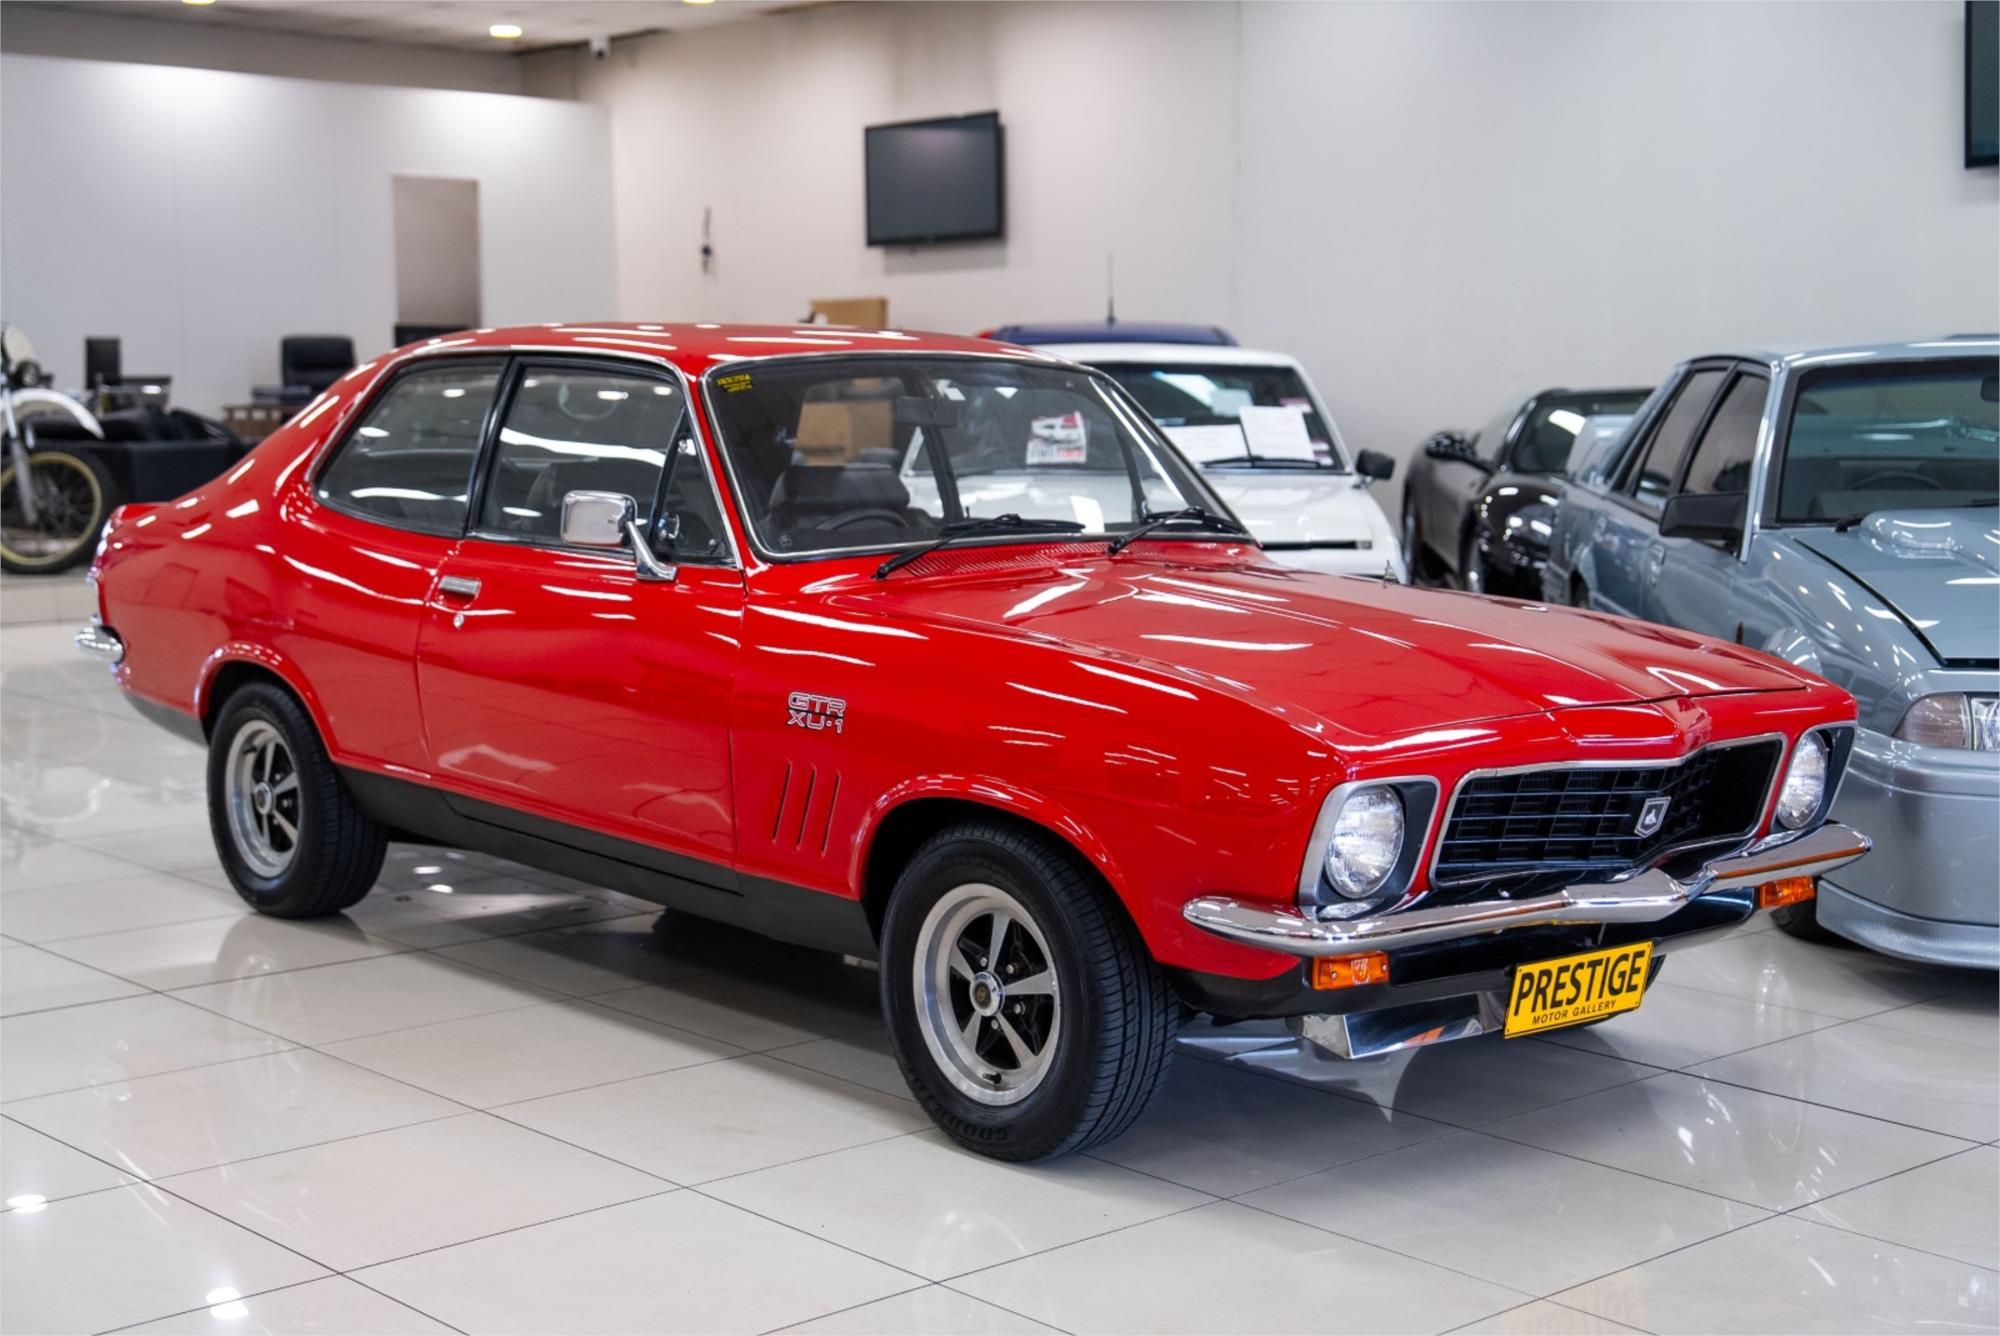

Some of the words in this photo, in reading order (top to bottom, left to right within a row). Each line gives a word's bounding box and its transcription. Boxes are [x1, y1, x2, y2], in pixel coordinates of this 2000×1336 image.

[788, 691, 846, 717] GTR
[1513, 950, 1646, 1017] PRESTIGE
[1531, 1010, 1569, 1025] MOTOR
[1572, 999, 1617, 1017] GALLERY
